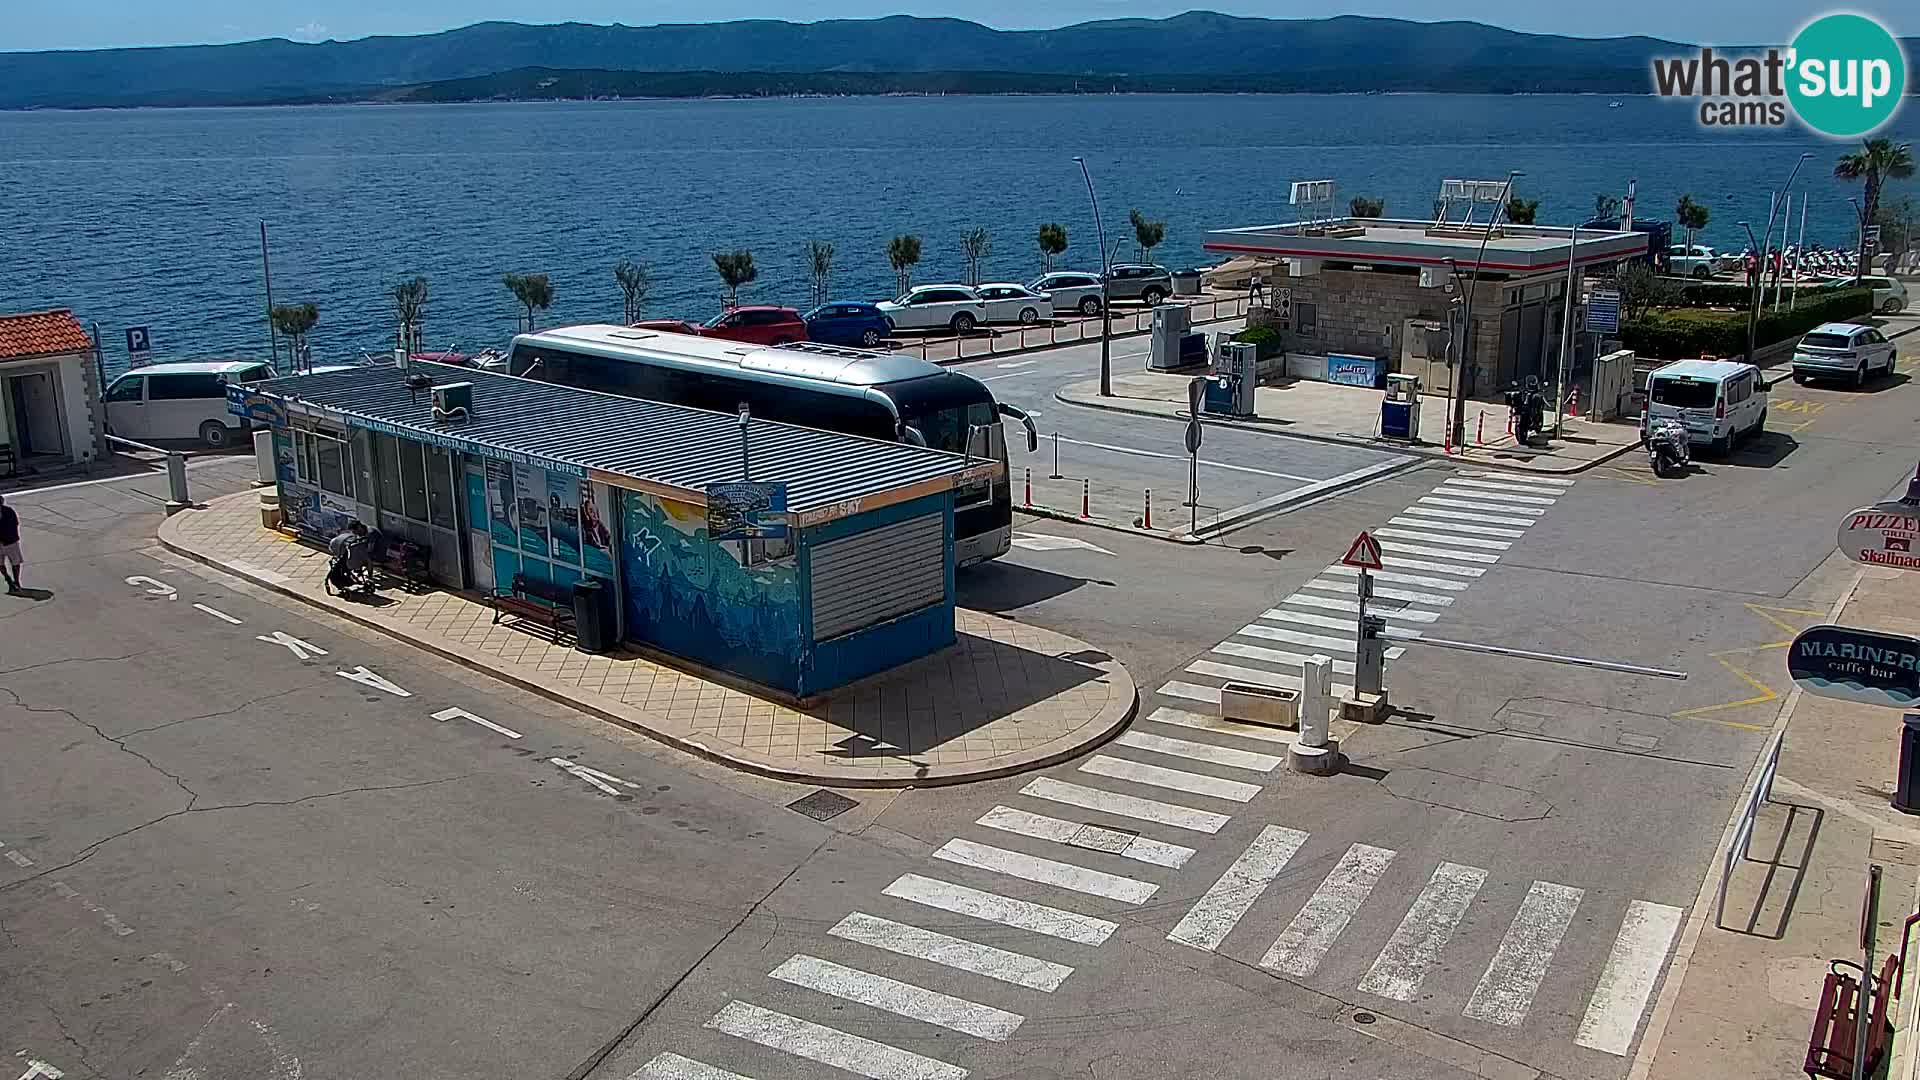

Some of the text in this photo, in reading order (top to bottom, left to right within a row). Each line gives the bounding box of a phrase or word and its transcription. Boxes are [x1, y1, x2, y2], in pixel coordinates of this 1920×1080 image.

[131, 330, 144, 349] P
[437, 435, 469, 451] POSTAJA
[479, 445, 494, 457] BUS
[495, 449, 527, 464] STATION
[529, 455, 555, 470] TICKET
[556, 462, 584, 477] OFFICE
[1848, 514, 1920, 533] PIZZE
[1827, 661, 1897, 679] caffe bar
